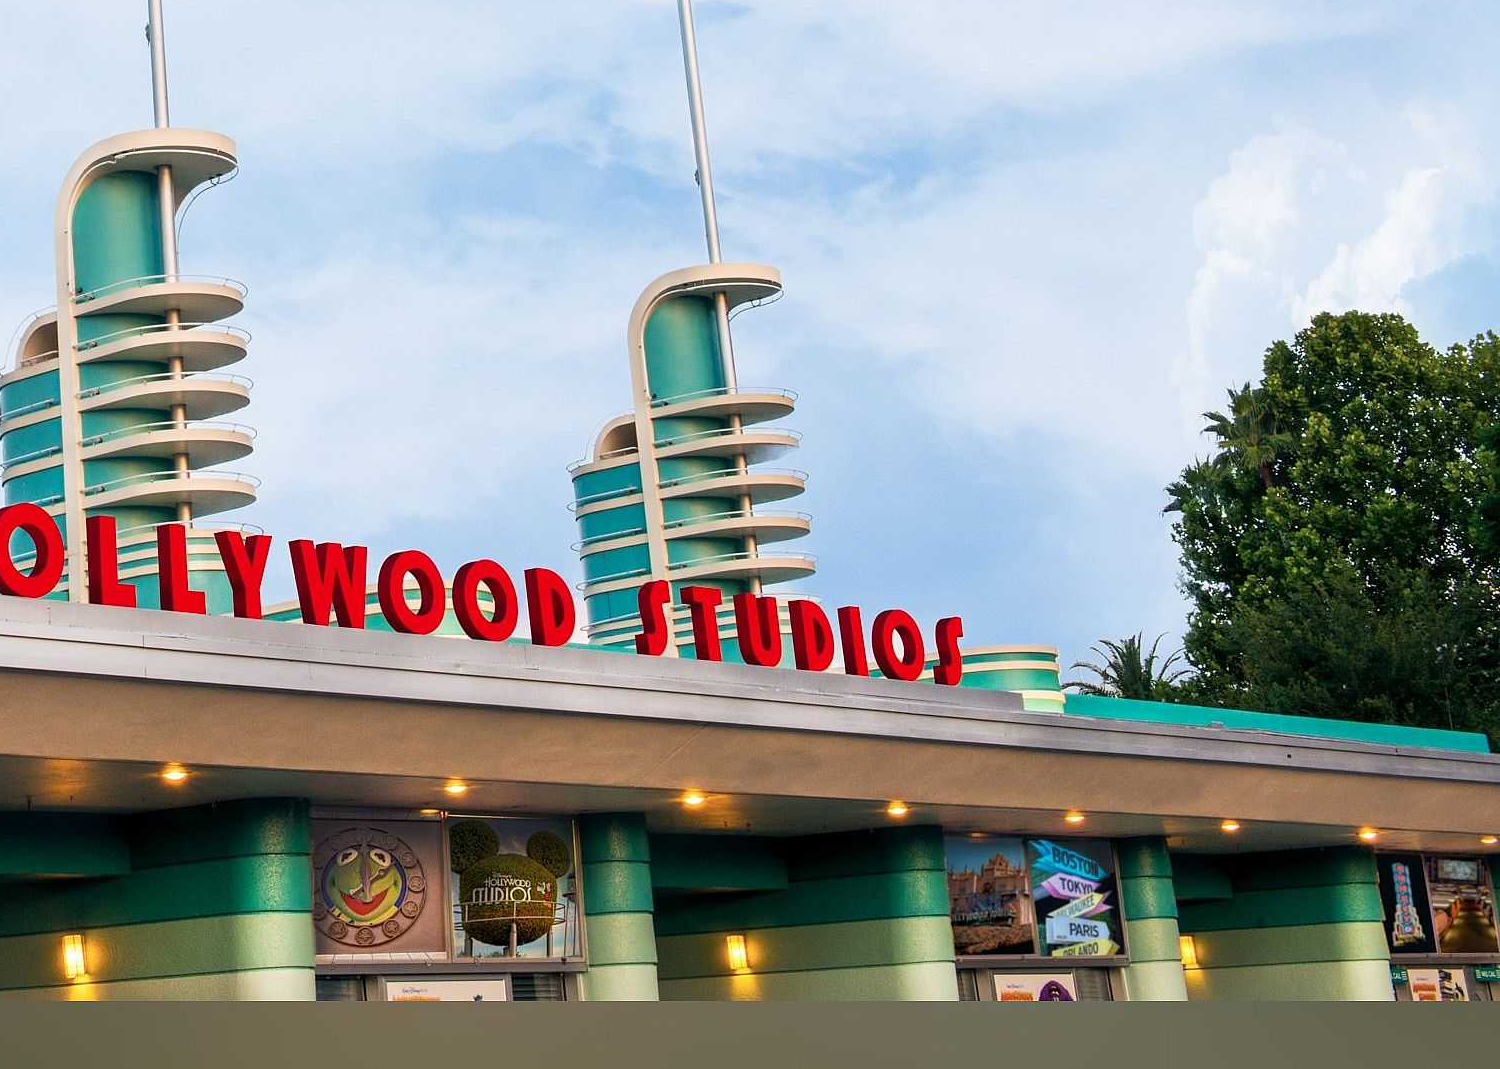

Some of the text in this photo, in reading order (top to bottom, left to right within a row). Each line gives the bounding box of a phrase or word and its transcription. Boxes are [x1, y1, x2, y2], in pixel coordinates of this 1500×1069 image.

[634, 578, 965, 688] STUDIOS
[1051, 845, 1100, 878] BOSTON
[484, 877, 532, 888] HOLLYWOOD
[1059, 877, 1094, 895] TOKYO
[472, 886, 532, 905] STUDIOS
[1069, 922, 1100, 938] PARIS
